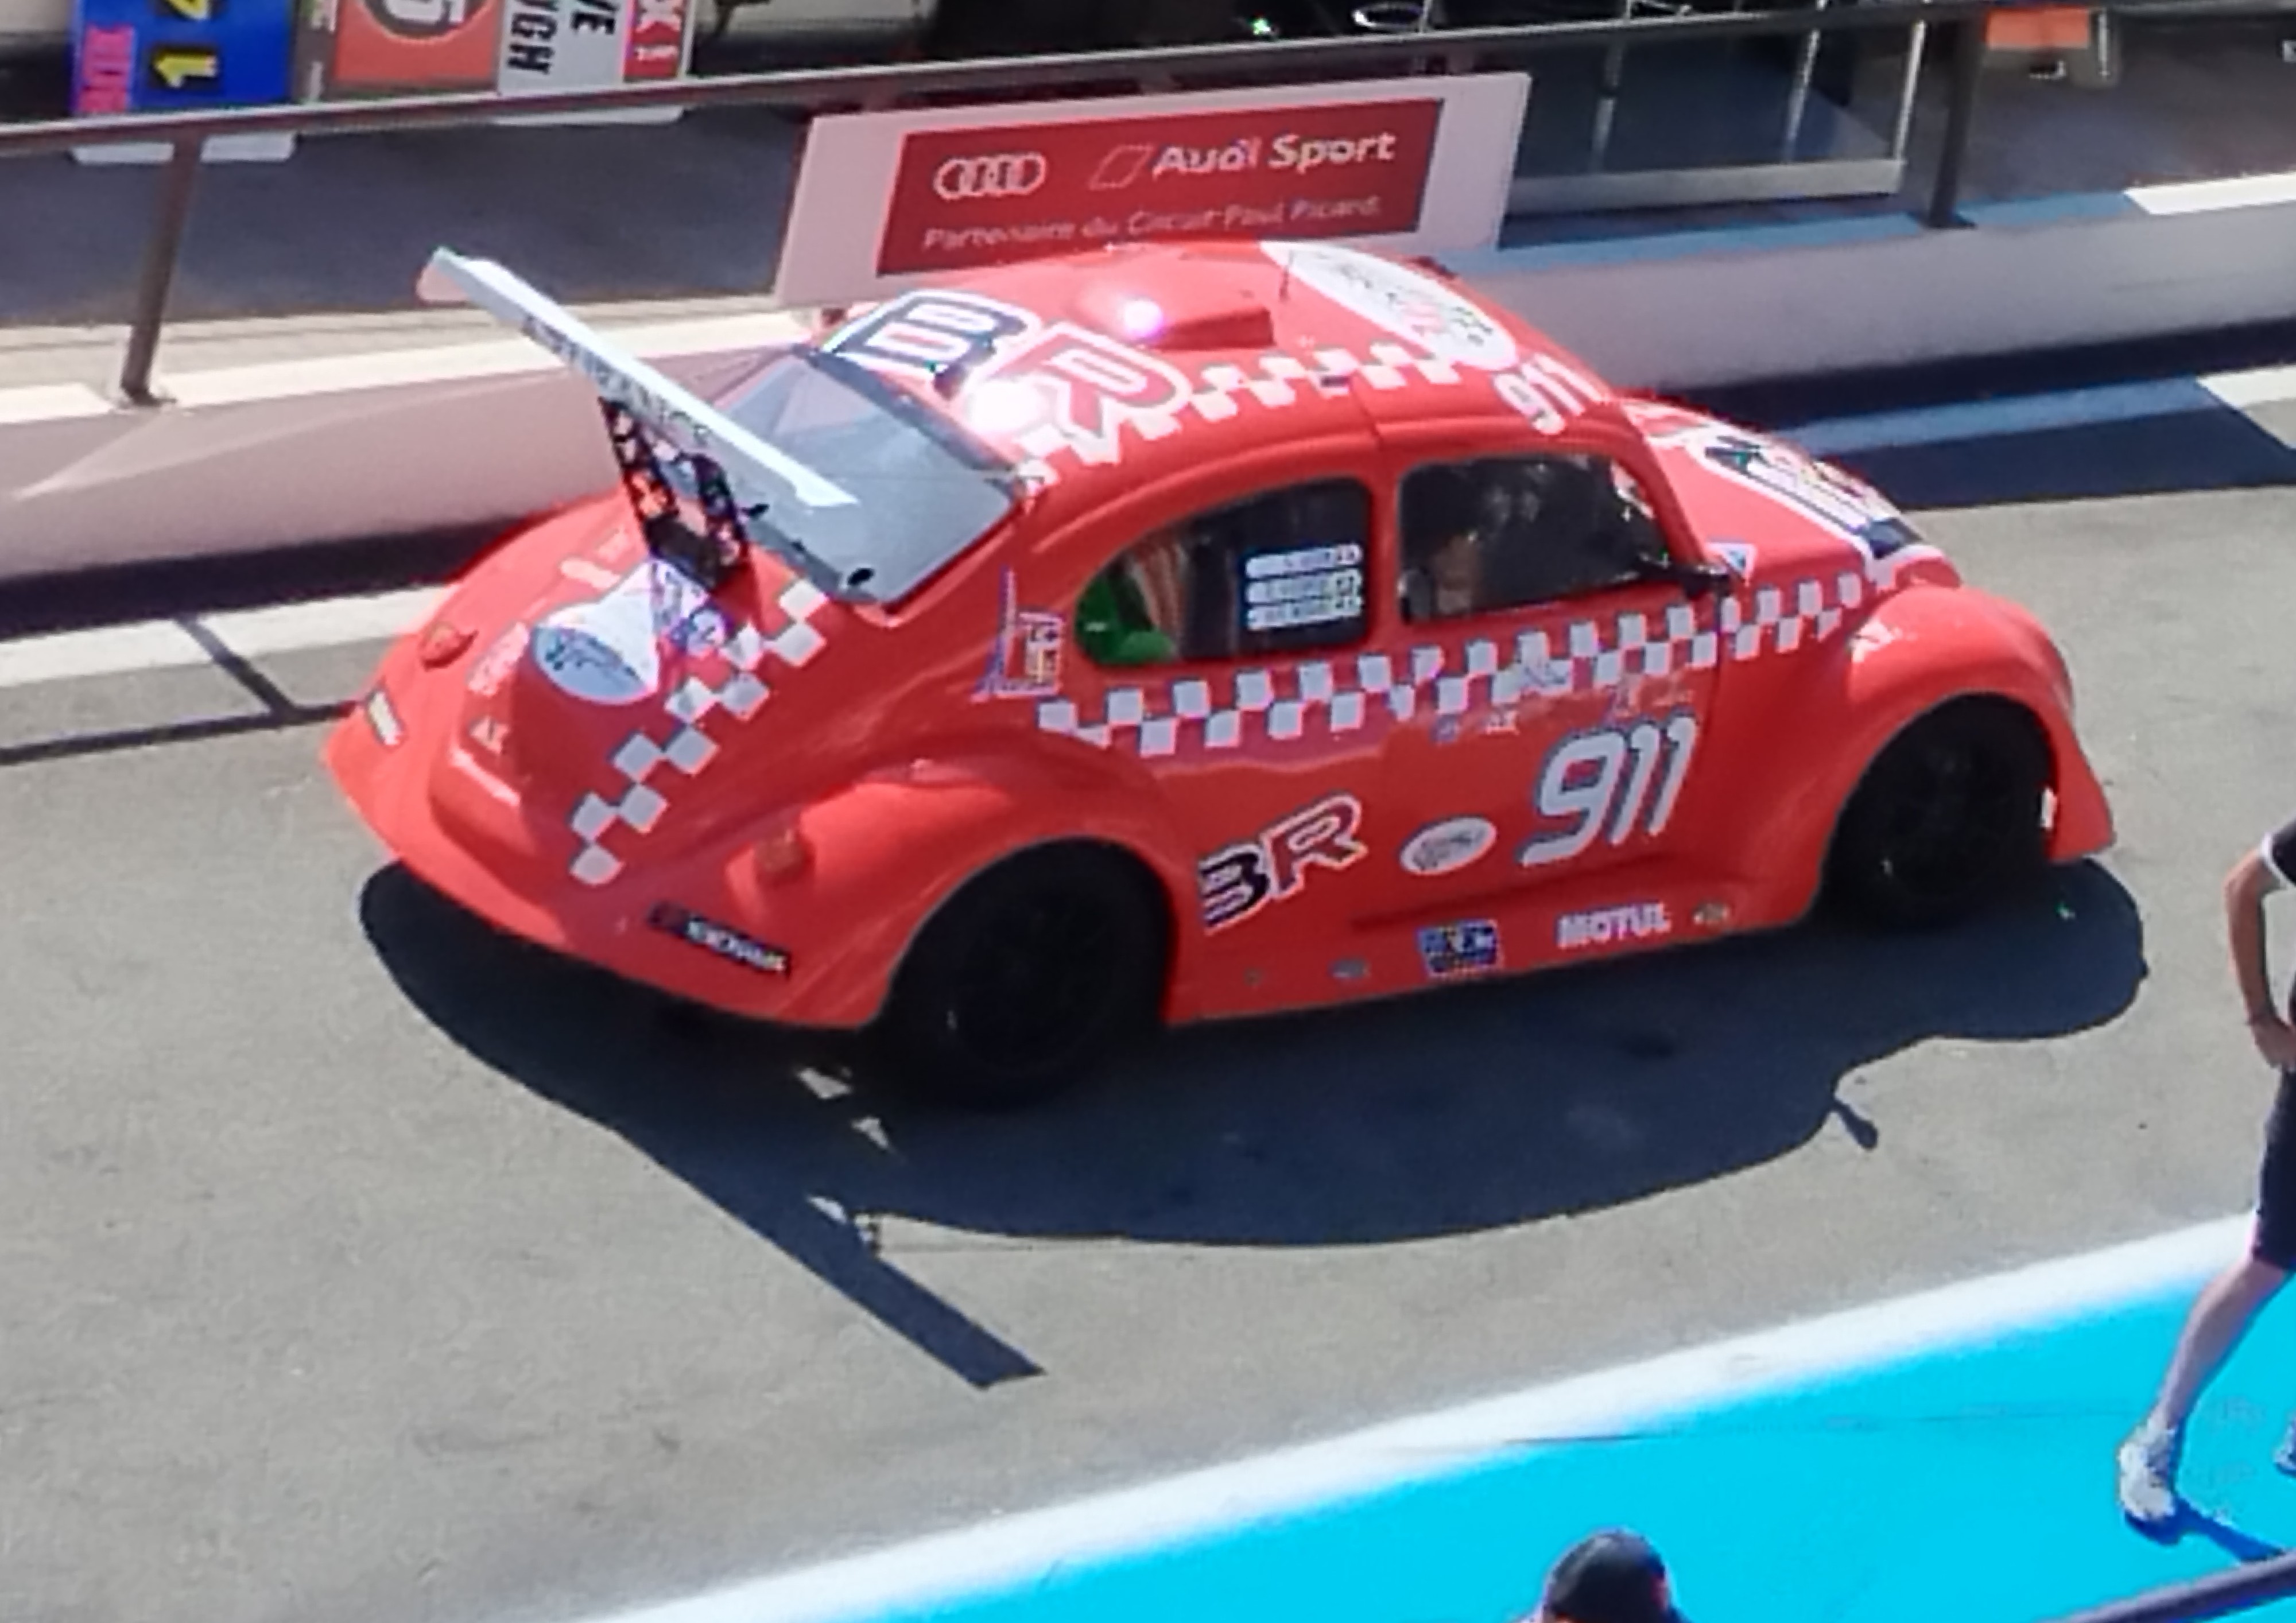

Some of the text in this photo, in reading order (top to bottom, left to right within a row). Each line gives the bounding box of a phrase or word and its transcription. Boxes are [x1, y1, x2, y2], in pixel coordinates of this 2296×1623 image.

[1153, 131, 1397, 181] Audi Sport
[1494, 351, 1612, 435] 911
[1518, 710, 1699, 868] 911
[1556, 900, 1672, 950] MOTUL
